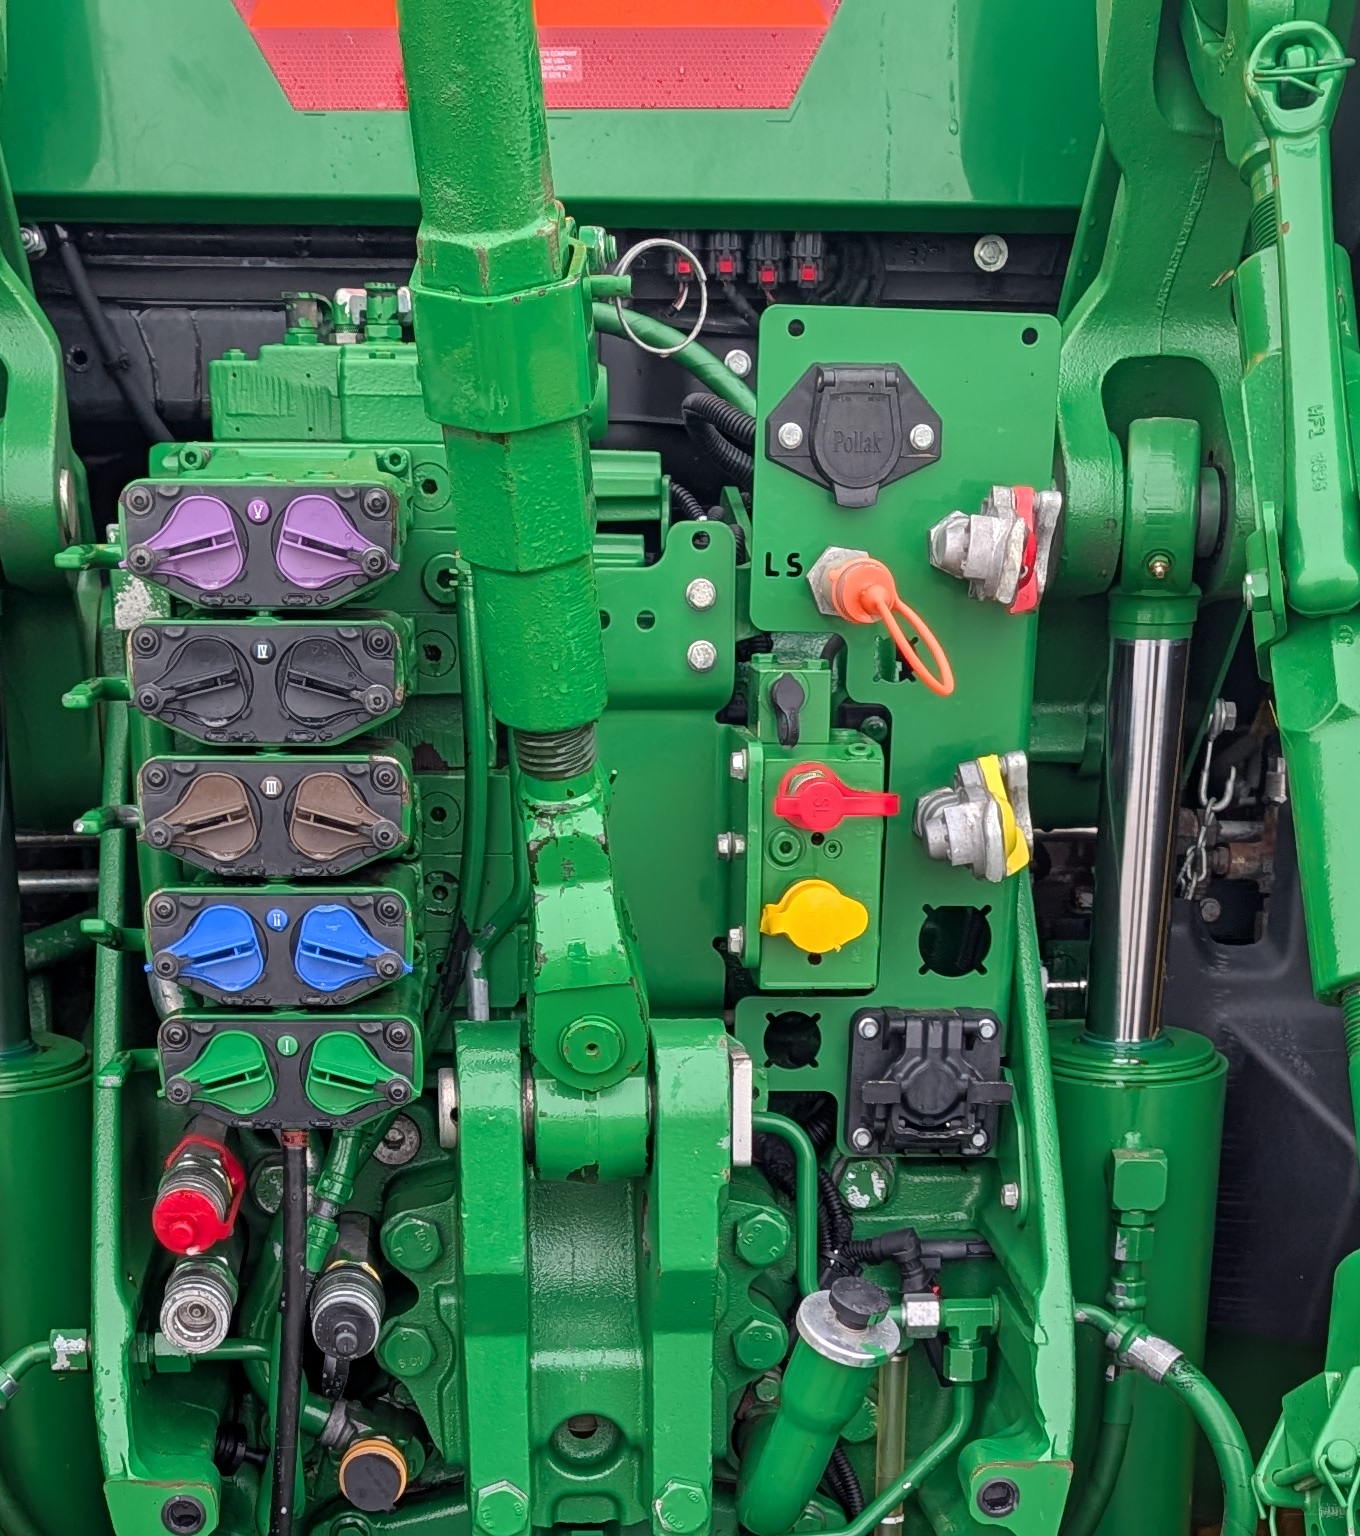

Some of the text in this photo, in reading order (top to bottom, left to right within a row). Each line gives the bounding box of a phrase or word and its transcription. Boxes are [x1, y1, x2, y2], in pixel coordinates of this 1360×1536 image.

[833, 429, 883, 454] Pollak
[765, 551, 803, 578] LS
[265, 780, 278, 795] III
